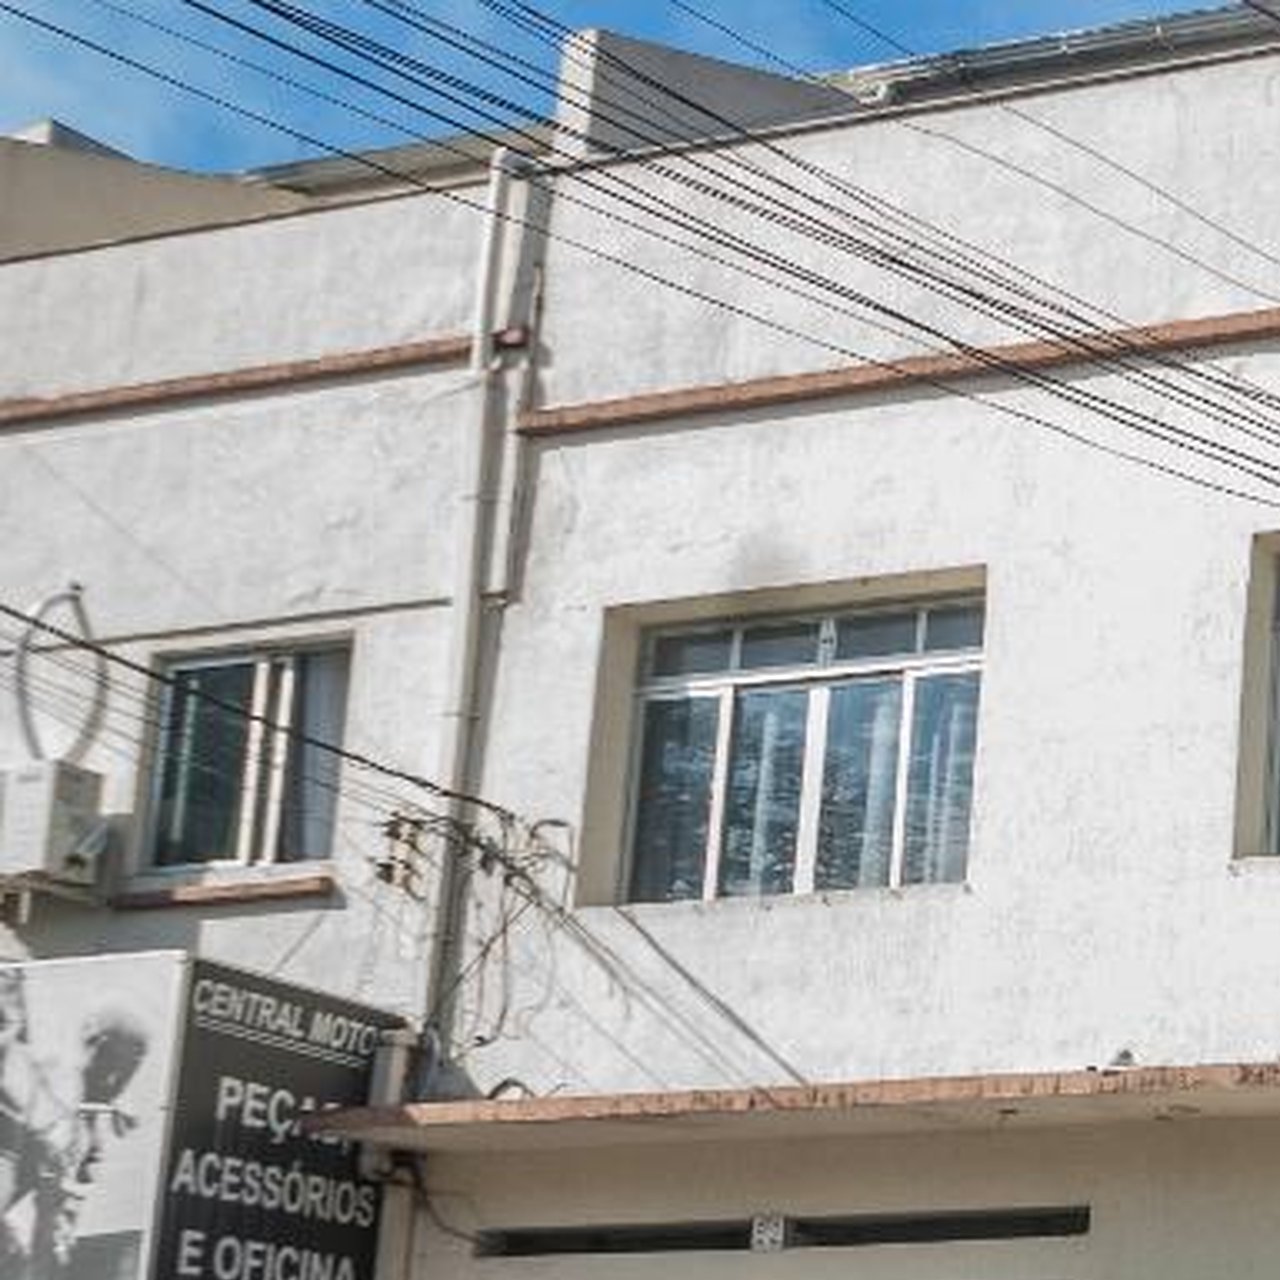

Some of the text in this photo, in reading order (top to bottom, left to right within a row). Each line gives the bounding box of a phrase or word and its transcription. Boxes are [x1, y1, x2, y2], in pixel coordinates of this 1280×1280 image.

[194, 980, 304, 1038] CENTRAL
[171, 1149, 376, 1227] ACESSÓRIOS
[177, 1229, 206, 1275] E
